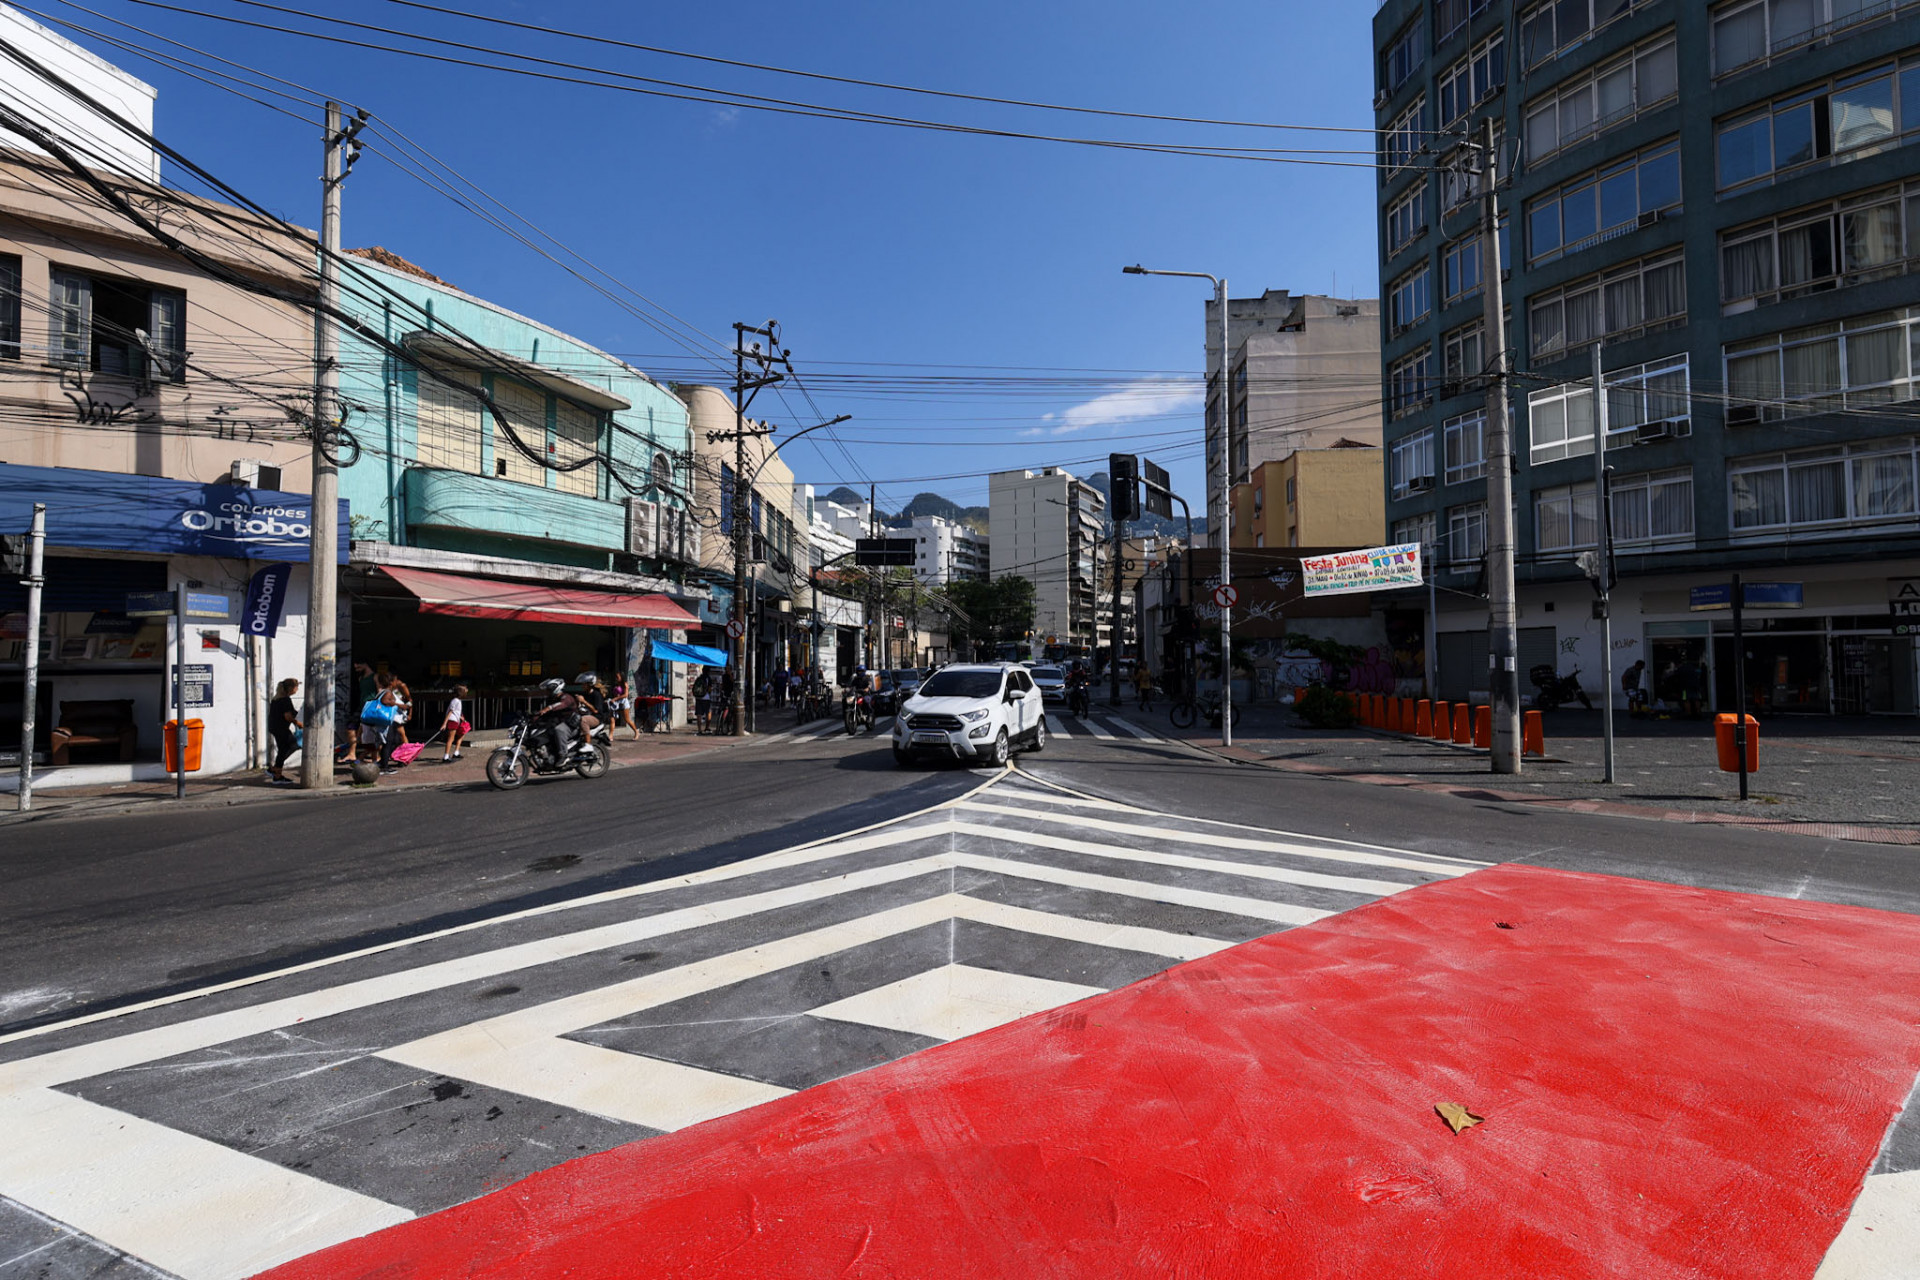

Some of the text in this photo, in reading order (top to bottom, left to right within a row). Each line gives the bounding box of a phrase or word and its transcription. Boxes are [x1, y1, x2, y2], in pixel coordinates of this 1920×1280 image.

[220, 502, 307, 519] COLCHÕES
[181, 509, 311, 538] Ortobo
[1303, 558, 1334, 571] Festa
[1333, 552, 1369, 568] Junina
[251, 574, 277, 632] Ortobom
